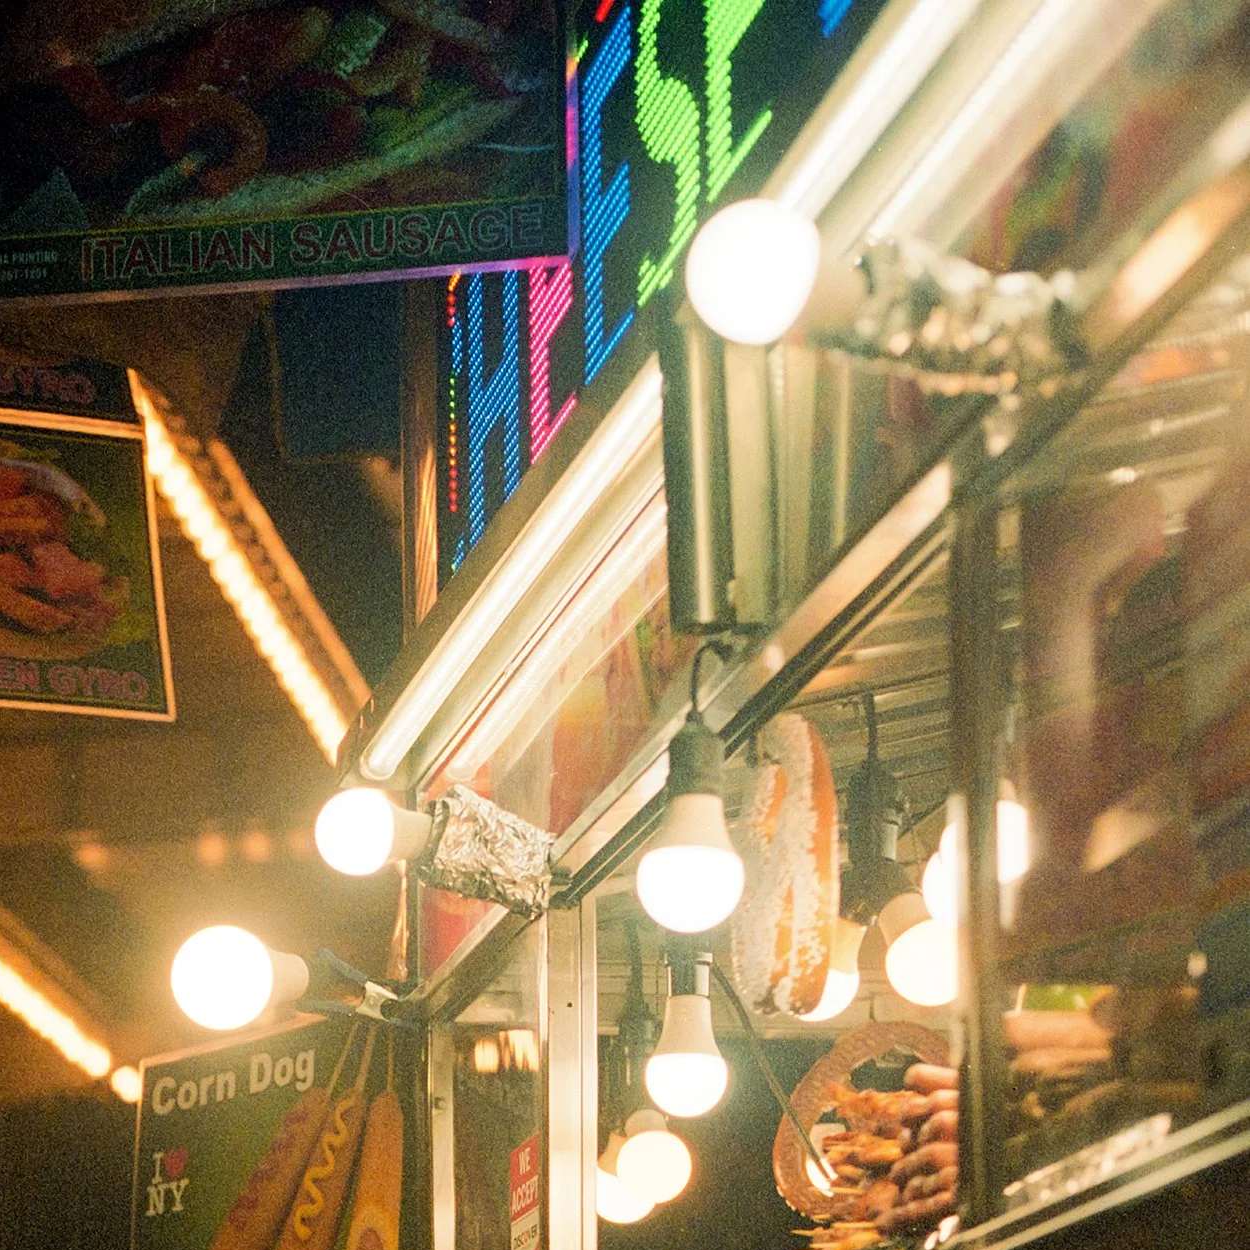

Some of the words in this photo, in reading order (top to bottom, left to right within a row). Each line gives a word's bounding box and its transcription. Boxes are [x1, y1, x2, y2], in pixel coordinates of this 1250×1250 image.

[80, 224, 274, 281] ITALIAN
[289, 203, 543, 266] SAUSAGE
[49, 665, 147, 701] GYRO
[151, 1069, 237, 1116] Corn
[250, 1050, 316, 1093] Dog
[518, 1146, 531, 1176] WE
[145, 1178, 190, 1216] NY
[511, 1175, 539, 1216] ACCEPT
